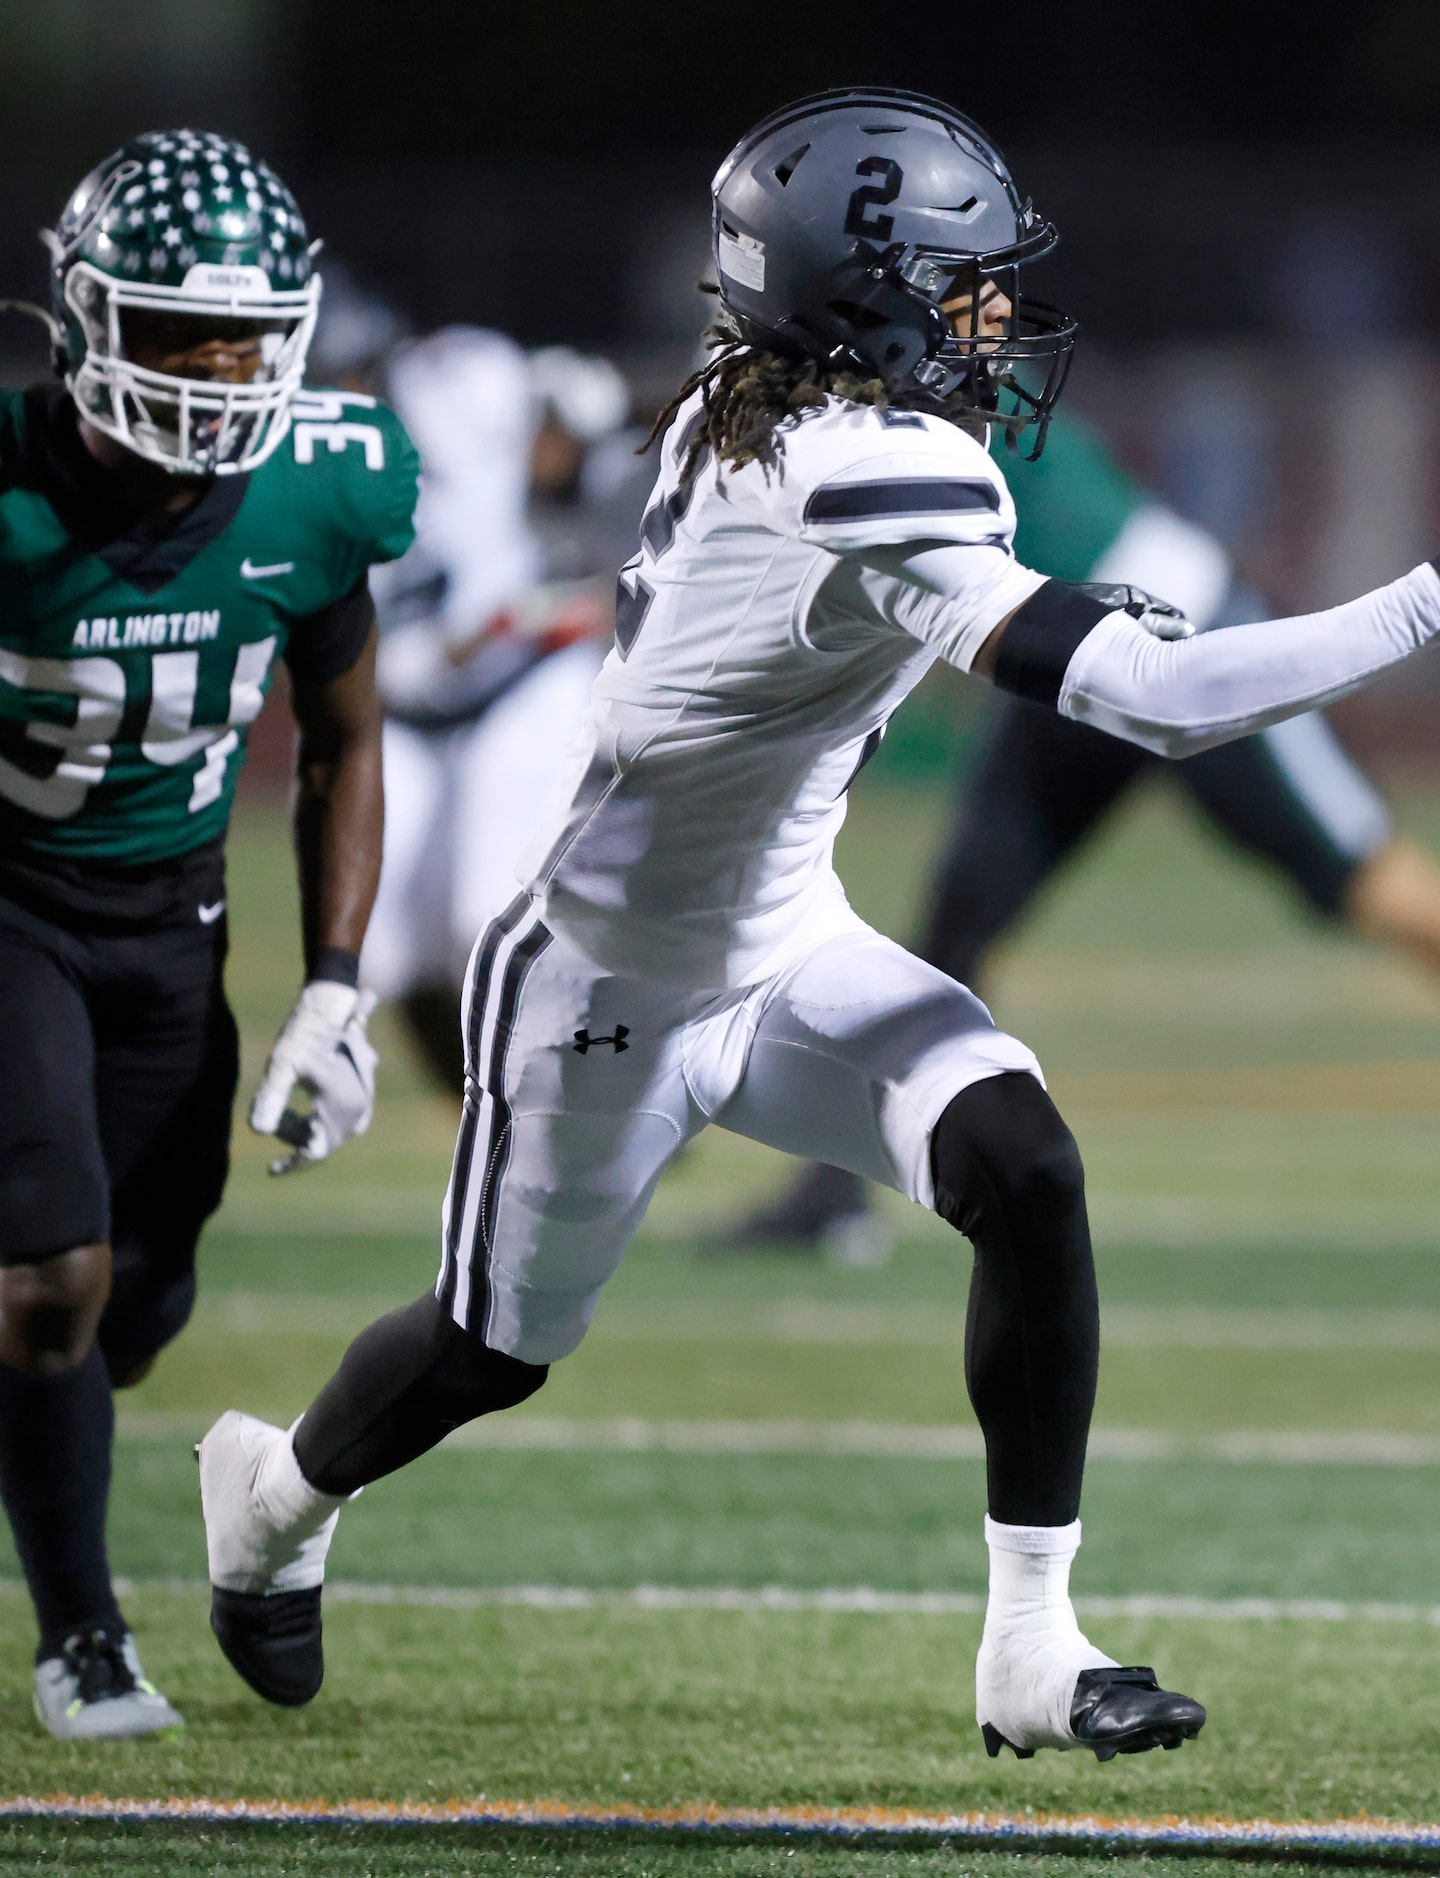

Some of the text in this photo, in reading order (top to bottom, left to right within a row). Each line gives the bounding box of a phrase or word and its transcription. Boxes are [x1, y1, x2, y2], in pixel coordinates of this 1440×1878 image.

[844, 156, 904, 242] 2
[71, 609, 221, 648] ARLINGTON
[0, 634, 277, 822] 34
